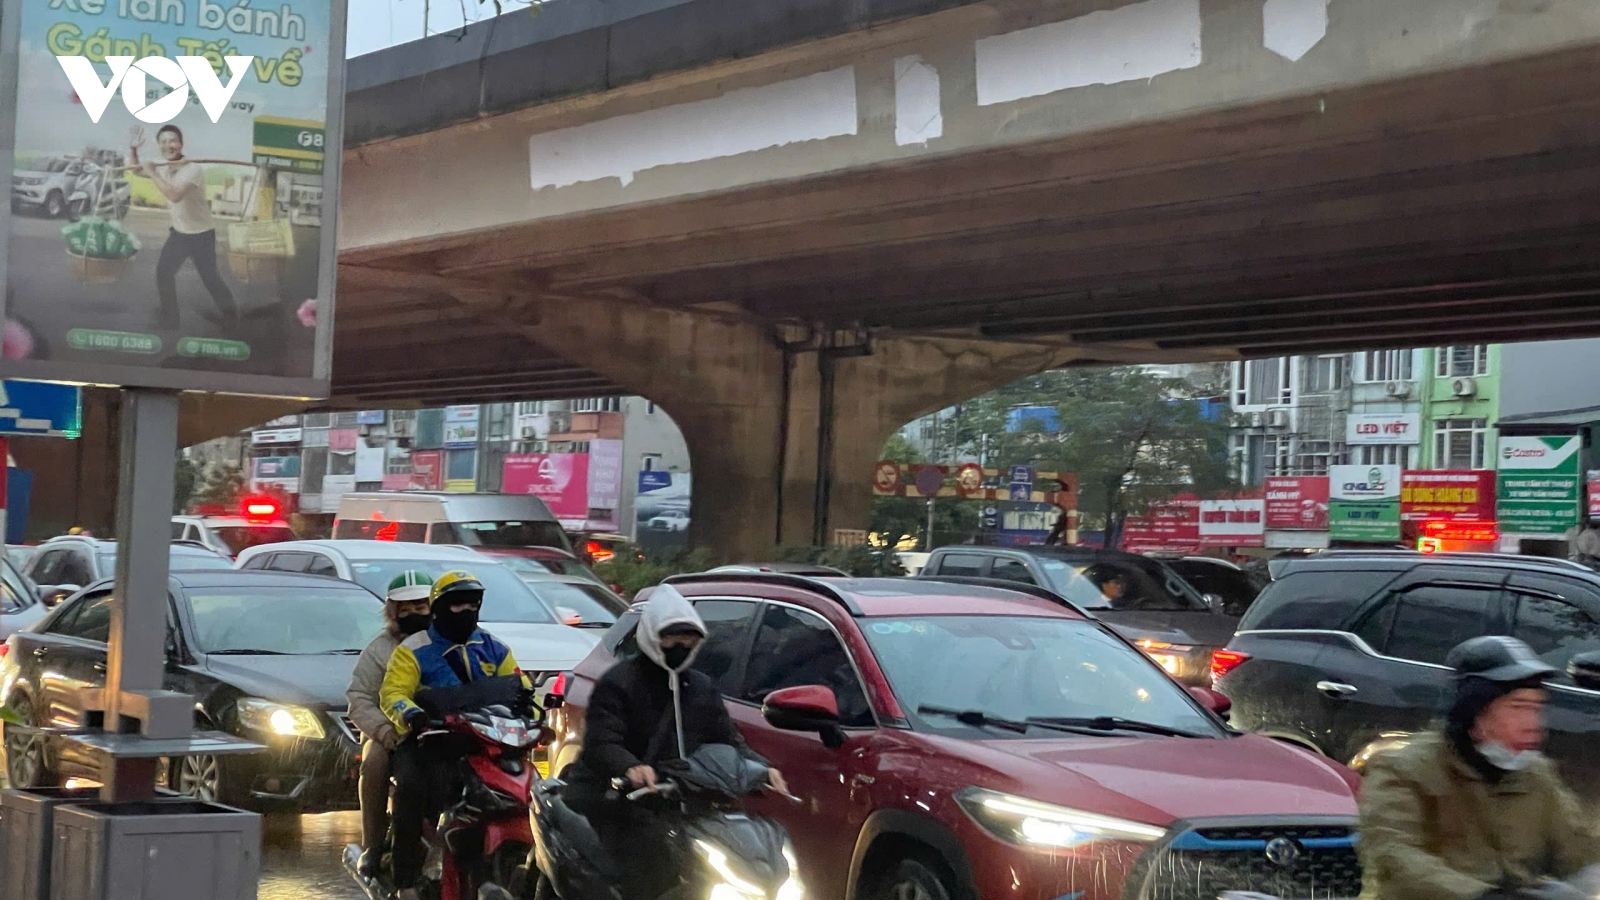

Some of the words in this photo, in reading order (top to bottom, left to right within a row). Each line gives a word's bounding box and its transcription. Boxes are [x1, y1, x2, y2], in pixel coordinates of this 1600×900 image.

[197, 0, 307, 41] bánh
[252, 47, 304, 88] về
[231, 101, 256, 113] vay
[1356, 423, 1379, 434] LED
